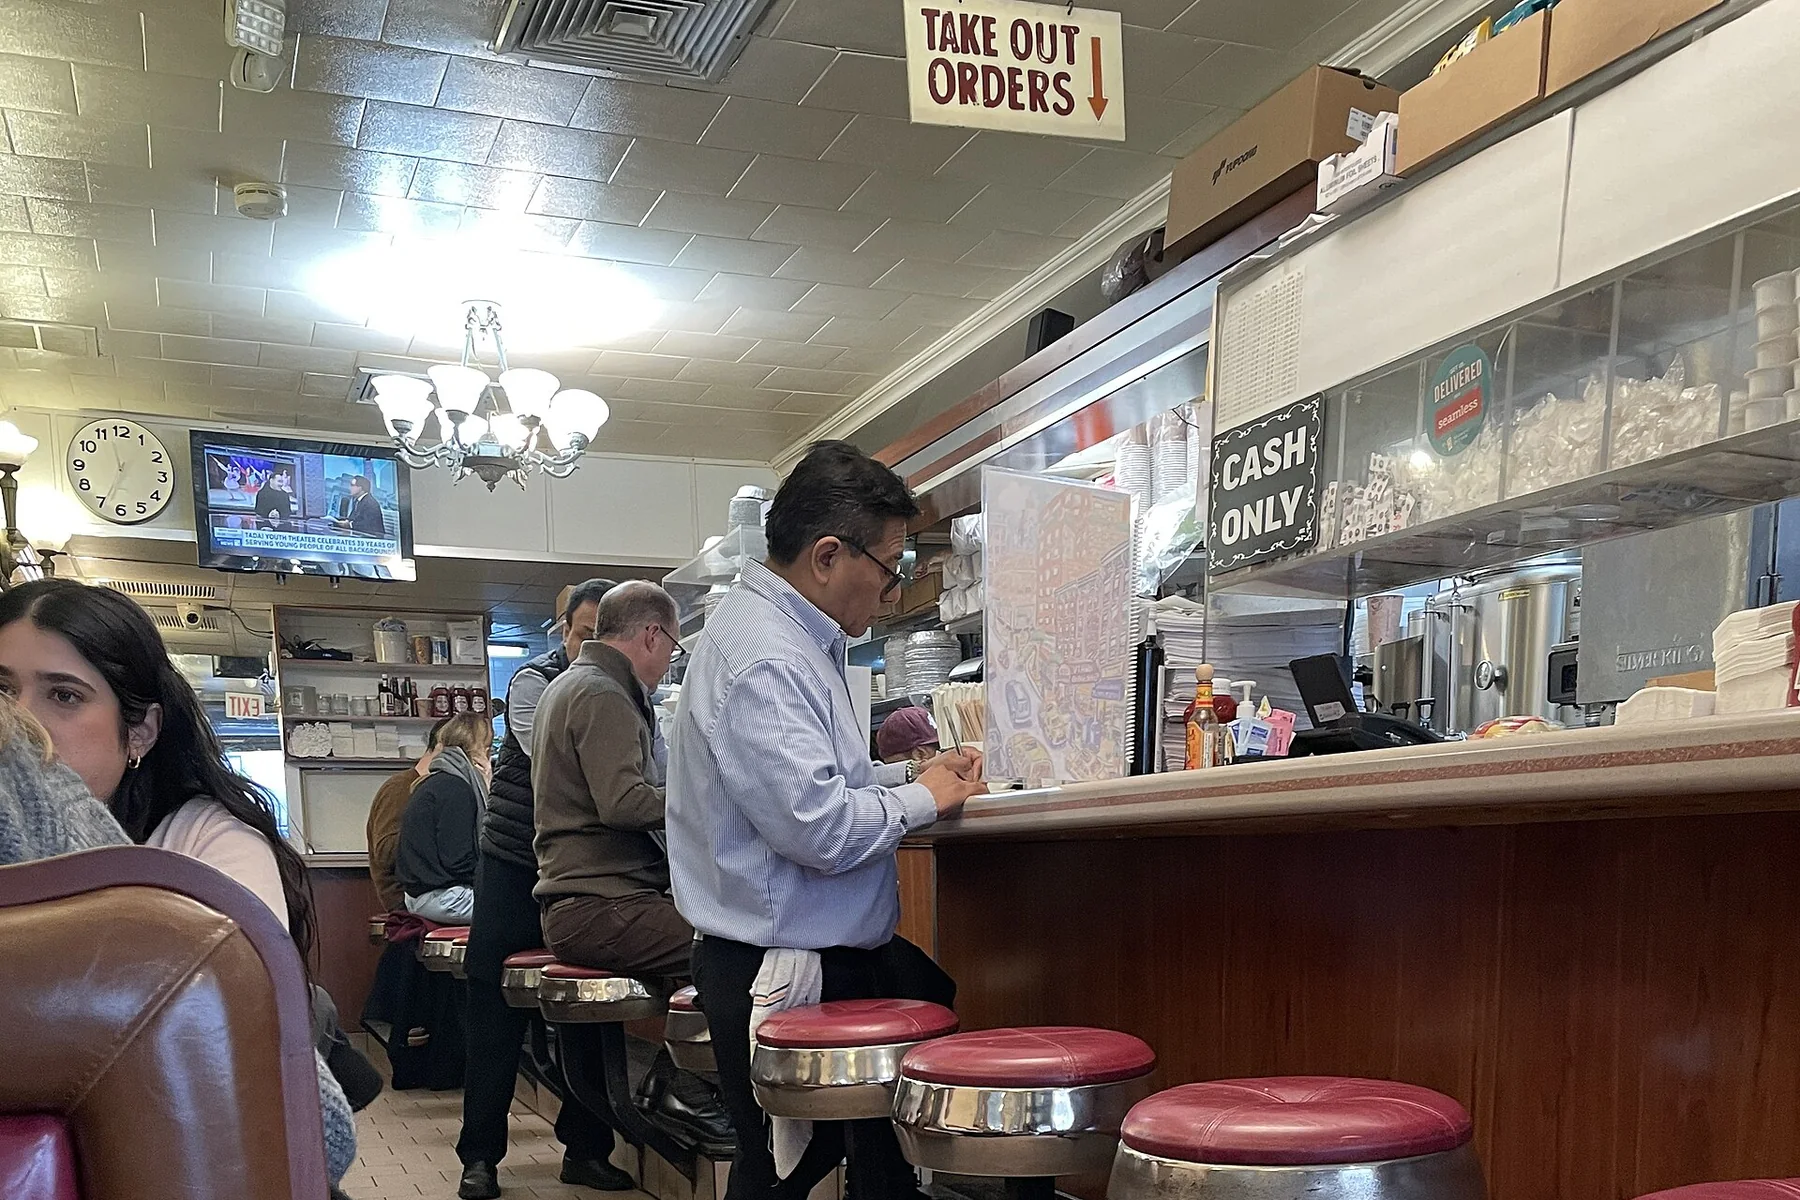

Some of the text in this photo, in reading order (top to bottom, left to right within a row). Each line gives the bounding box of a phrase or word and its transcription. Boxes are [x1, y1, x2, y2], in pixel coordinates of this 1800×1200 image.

[921, 8, 1079, 65] TAKE OUT
[928, 57, 1075, 116] ORDERS
[1434, 358, 1482, 403] DELIVERED
[1438, 398, 1478, 430] seamless
[95, 428, 107, 440] 11
[112, 425, 130, 439] 12
[79, 440, 97, 453] 10
[138, 434, 144, 446] 1
[151, 450, 163, 464] 2
[1222, 425, 1307, 491] CASH
[72, 458, 85, 471] 9
[157, 471, 168, 483] 3
[79, 478, 91, 491] 8
[95, 495, 106, 508] 7
[149, 489, 161, 502] 4
[115, 504, 127, 516] 6
[135, 502, 147, 514] 5
[1221, 485, 1305, 546] ONLY
[245, 538, 274, 547] SERVING
[274, 540, 298, 548] YOUNG
[299, 542, 324, 550] PEOPLE
[265, 533, 287, 541] YOUTH
[288, 534, 316, 543] THEATER
[317, 537, 356, 547] CELEBRATES
[1616, 651, 1657, 672] SILVER
